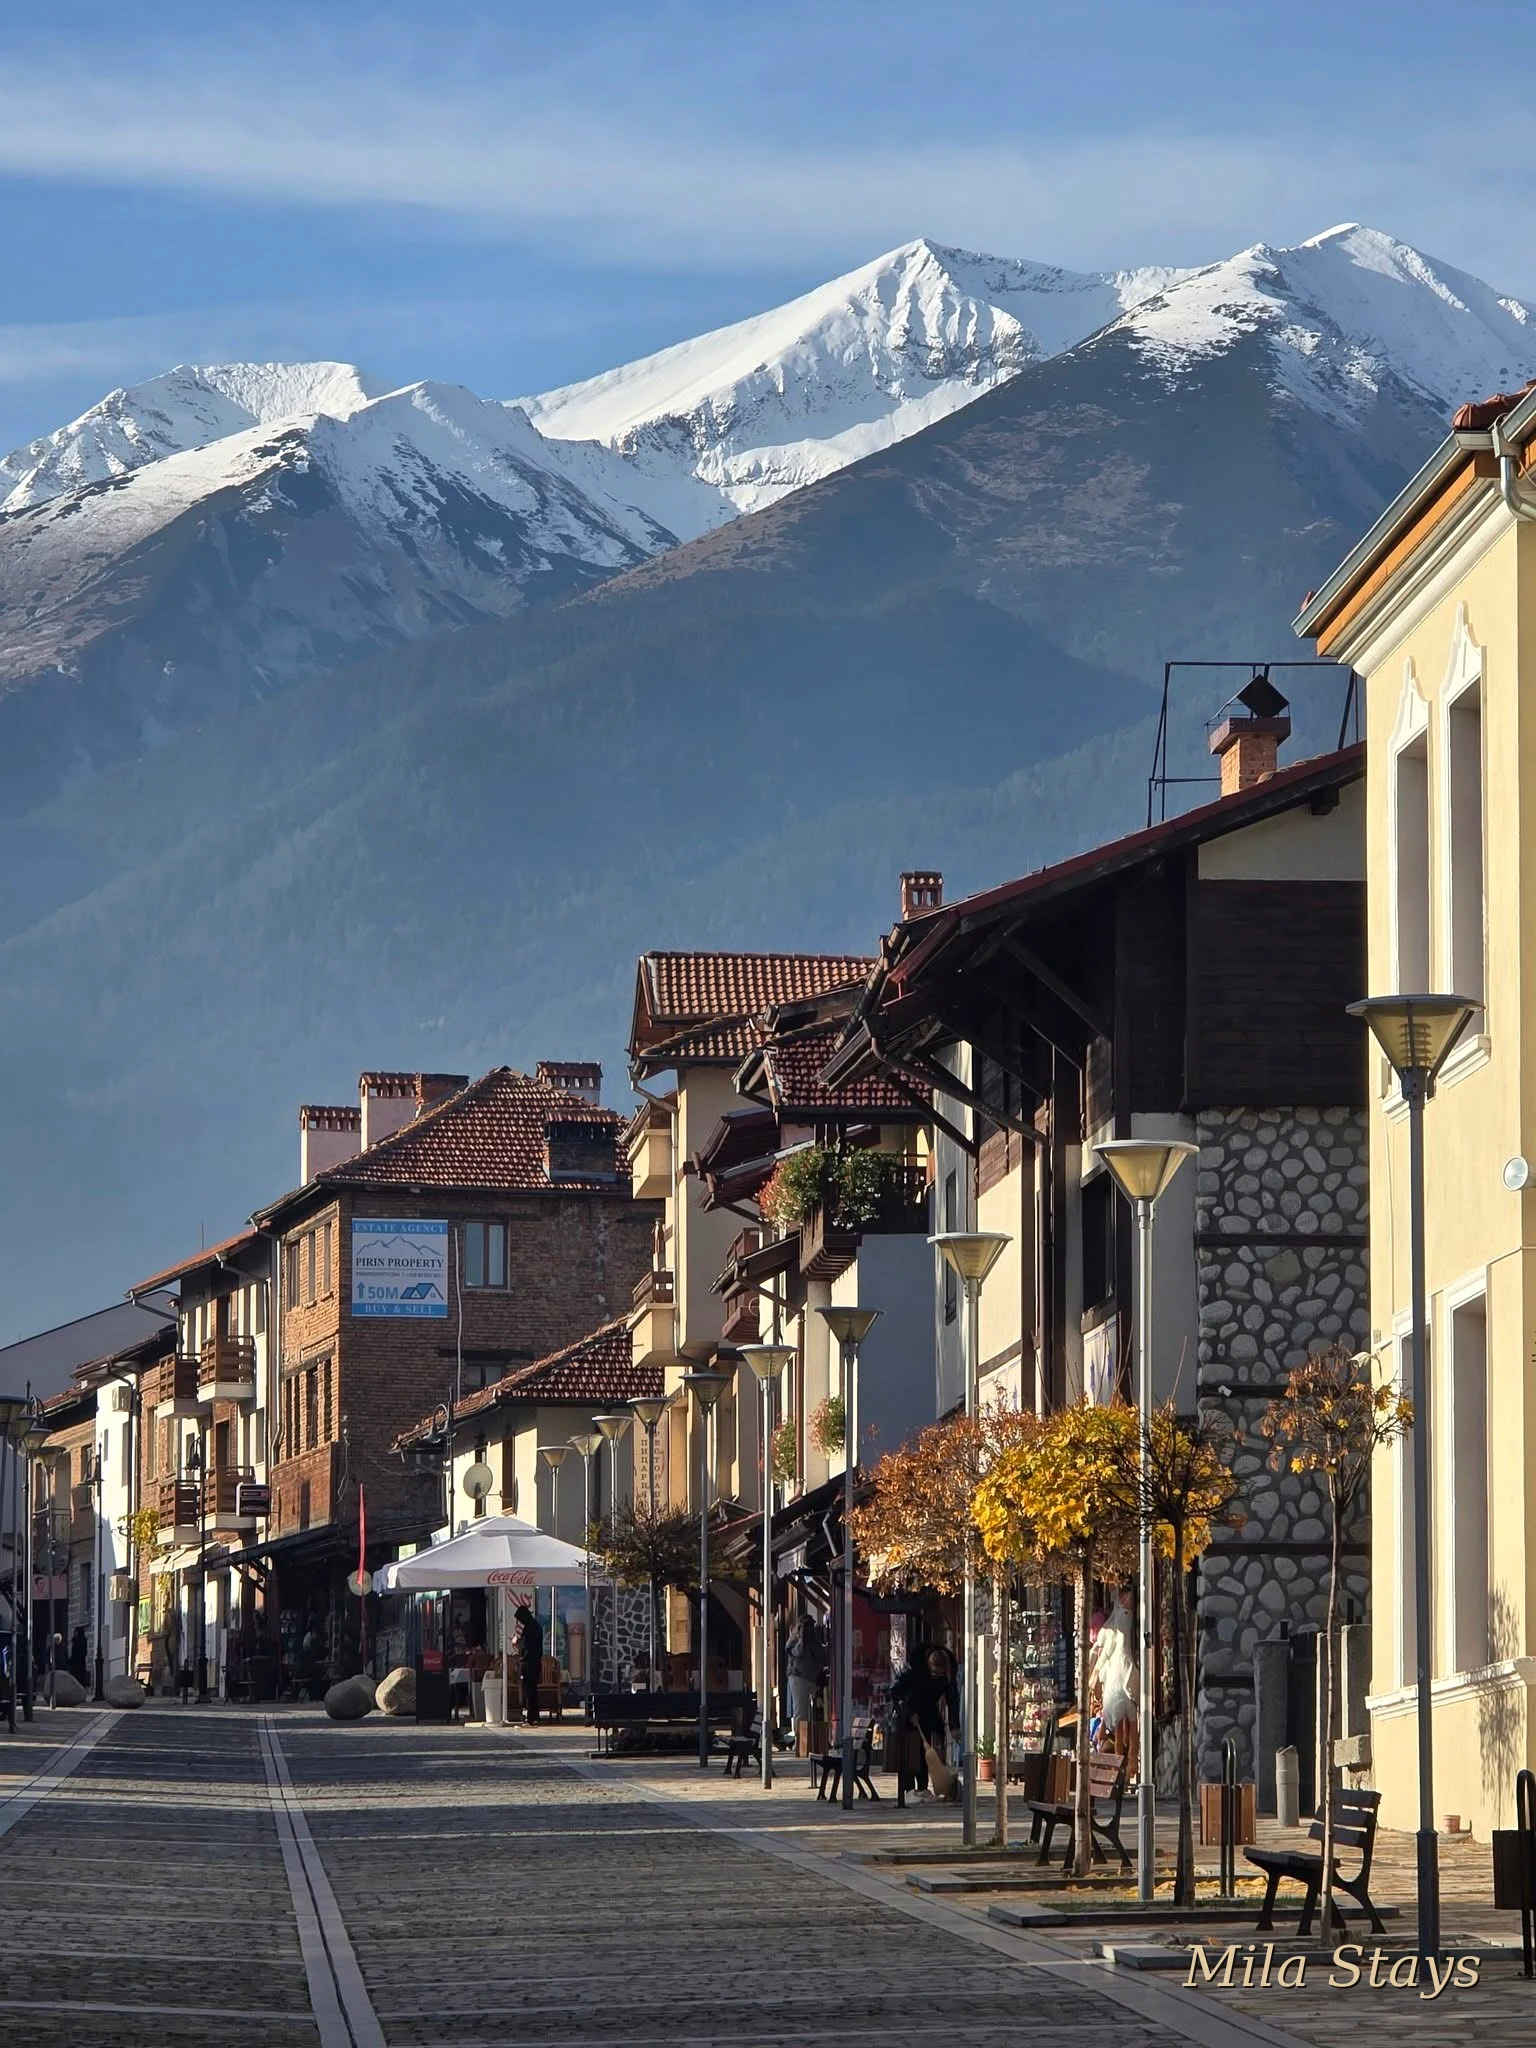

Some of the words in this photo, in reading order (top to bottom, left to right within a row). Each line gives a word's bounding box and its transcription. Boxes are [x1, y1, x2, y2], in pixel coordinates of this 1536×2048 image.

[356, 1223, 396, 1232] ESTATE
[400, 1224, 445, 1233] AGENCY
[355, 1258, 385, 1267] PIRIN
[388, 1258, 443, 1269] PROPERTY
[368, 1287, 398, 1299] 50M
[365, 1304, 388, 1314] BUY
[392, 1305, 401, 1314] &
[405, 1305, 433, 1315] SELL
